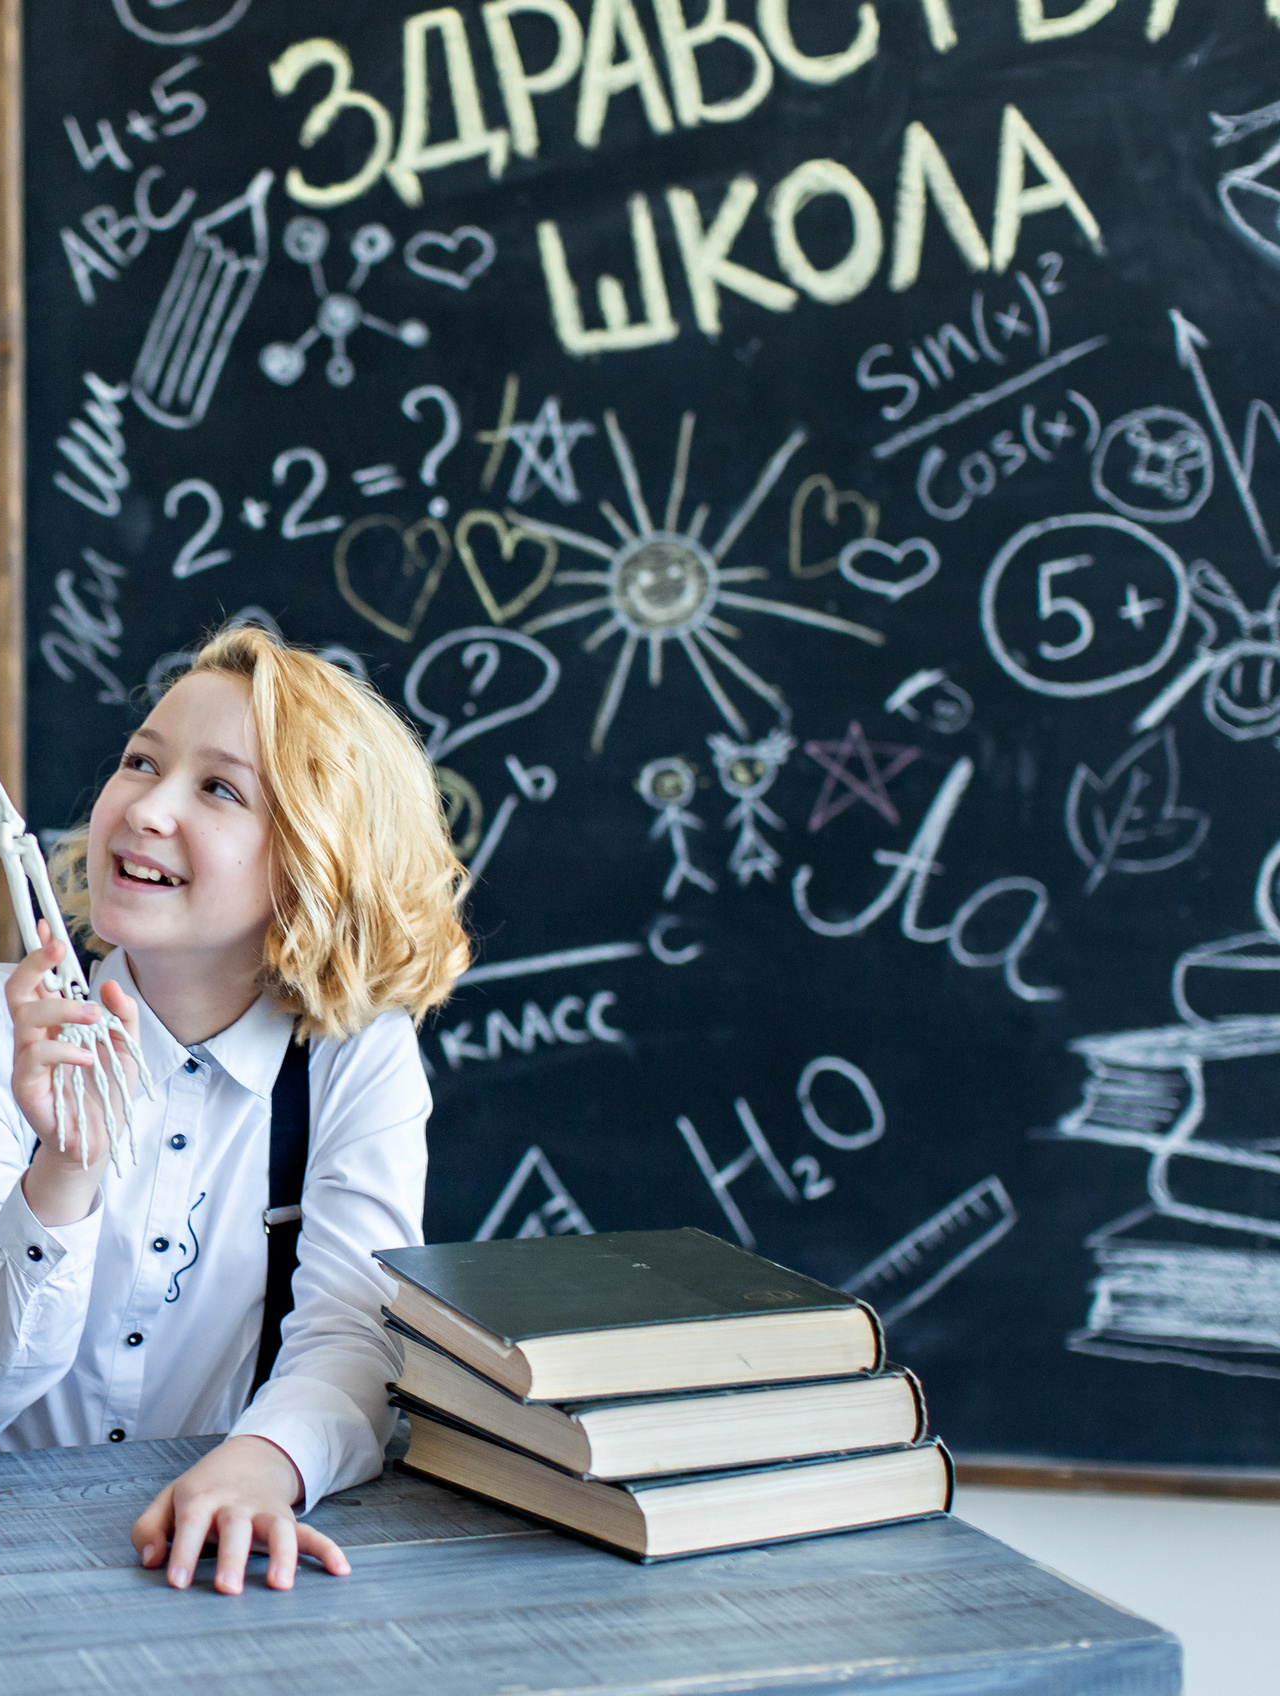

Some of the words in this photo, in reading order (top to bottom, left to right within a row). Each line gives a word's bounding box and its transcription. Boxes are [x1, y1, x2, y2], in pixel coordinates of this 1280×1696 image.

[268, 0, 1280, 207] ЗДРАВС
[536, 102, 1107, 358] ШКОЛА
[438, 990, 625, 1072] КЛАСС
